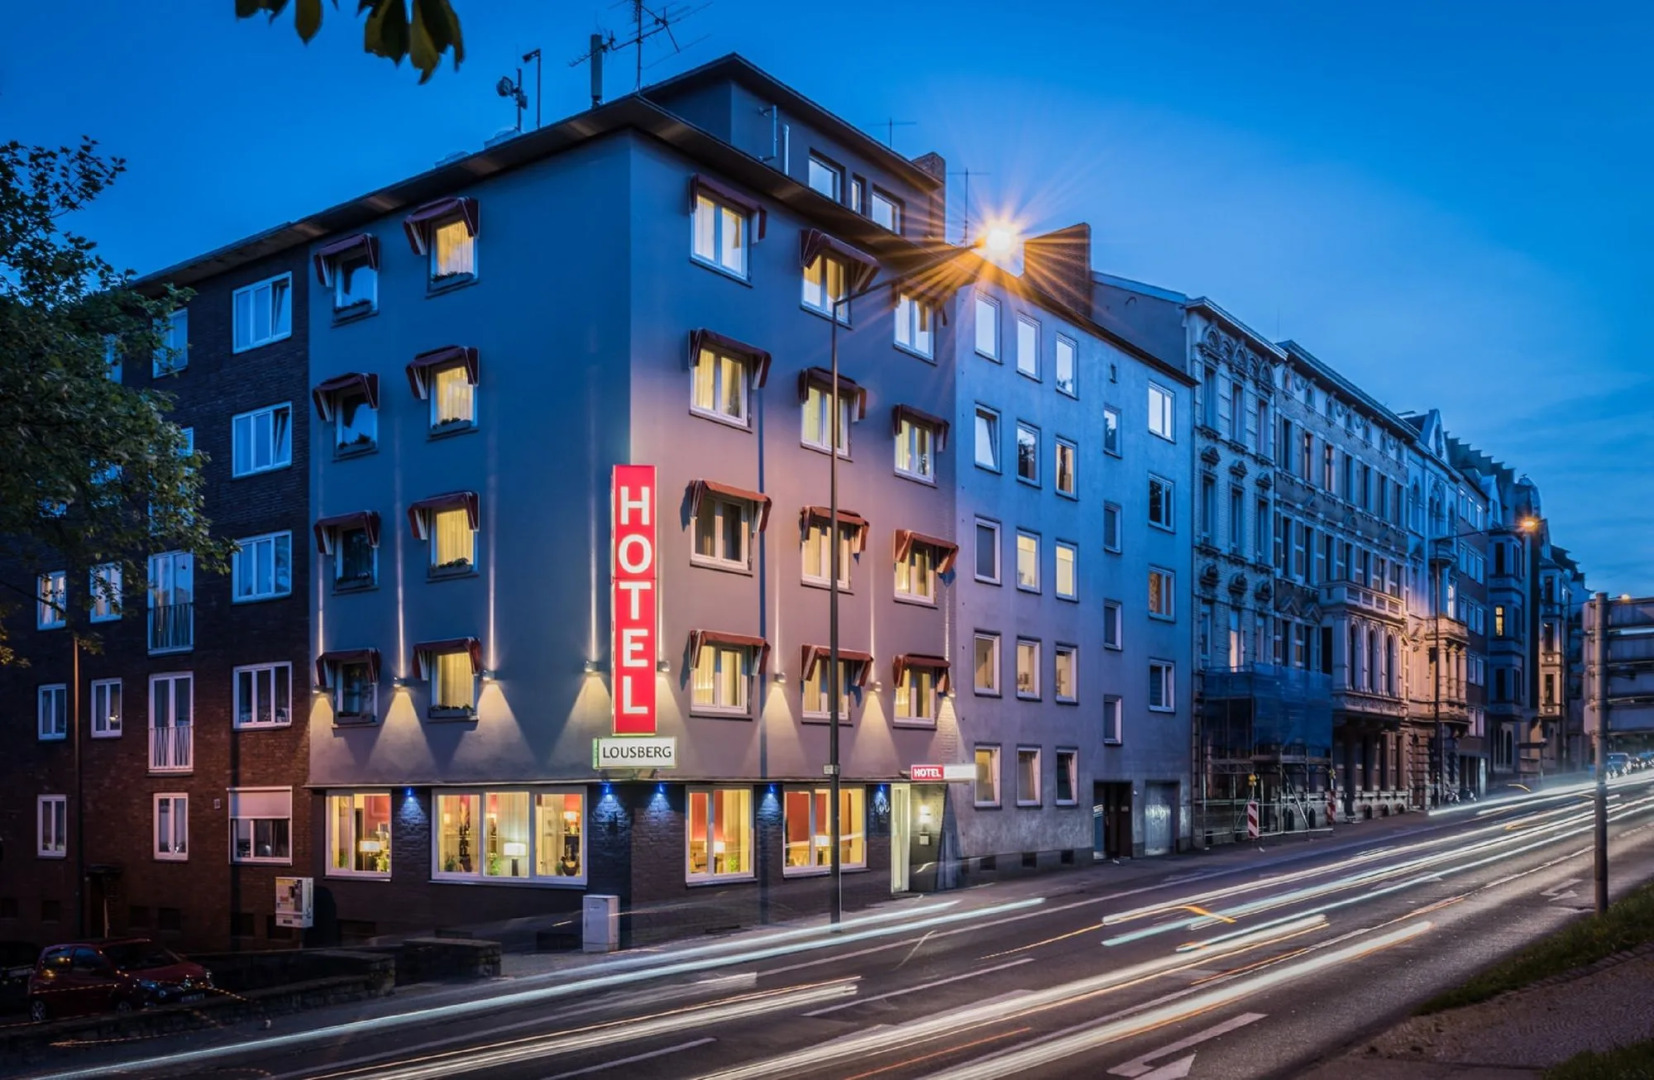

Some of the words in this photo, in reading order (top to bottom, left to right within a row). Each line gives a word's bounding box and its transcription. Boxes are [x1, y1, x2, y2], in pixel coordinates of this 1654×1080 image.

[618, 486, 652, 715] HOTEL
[602, 746, 672, 758] LOUSBERG
[913, 768, 941, 778] HOTEL
